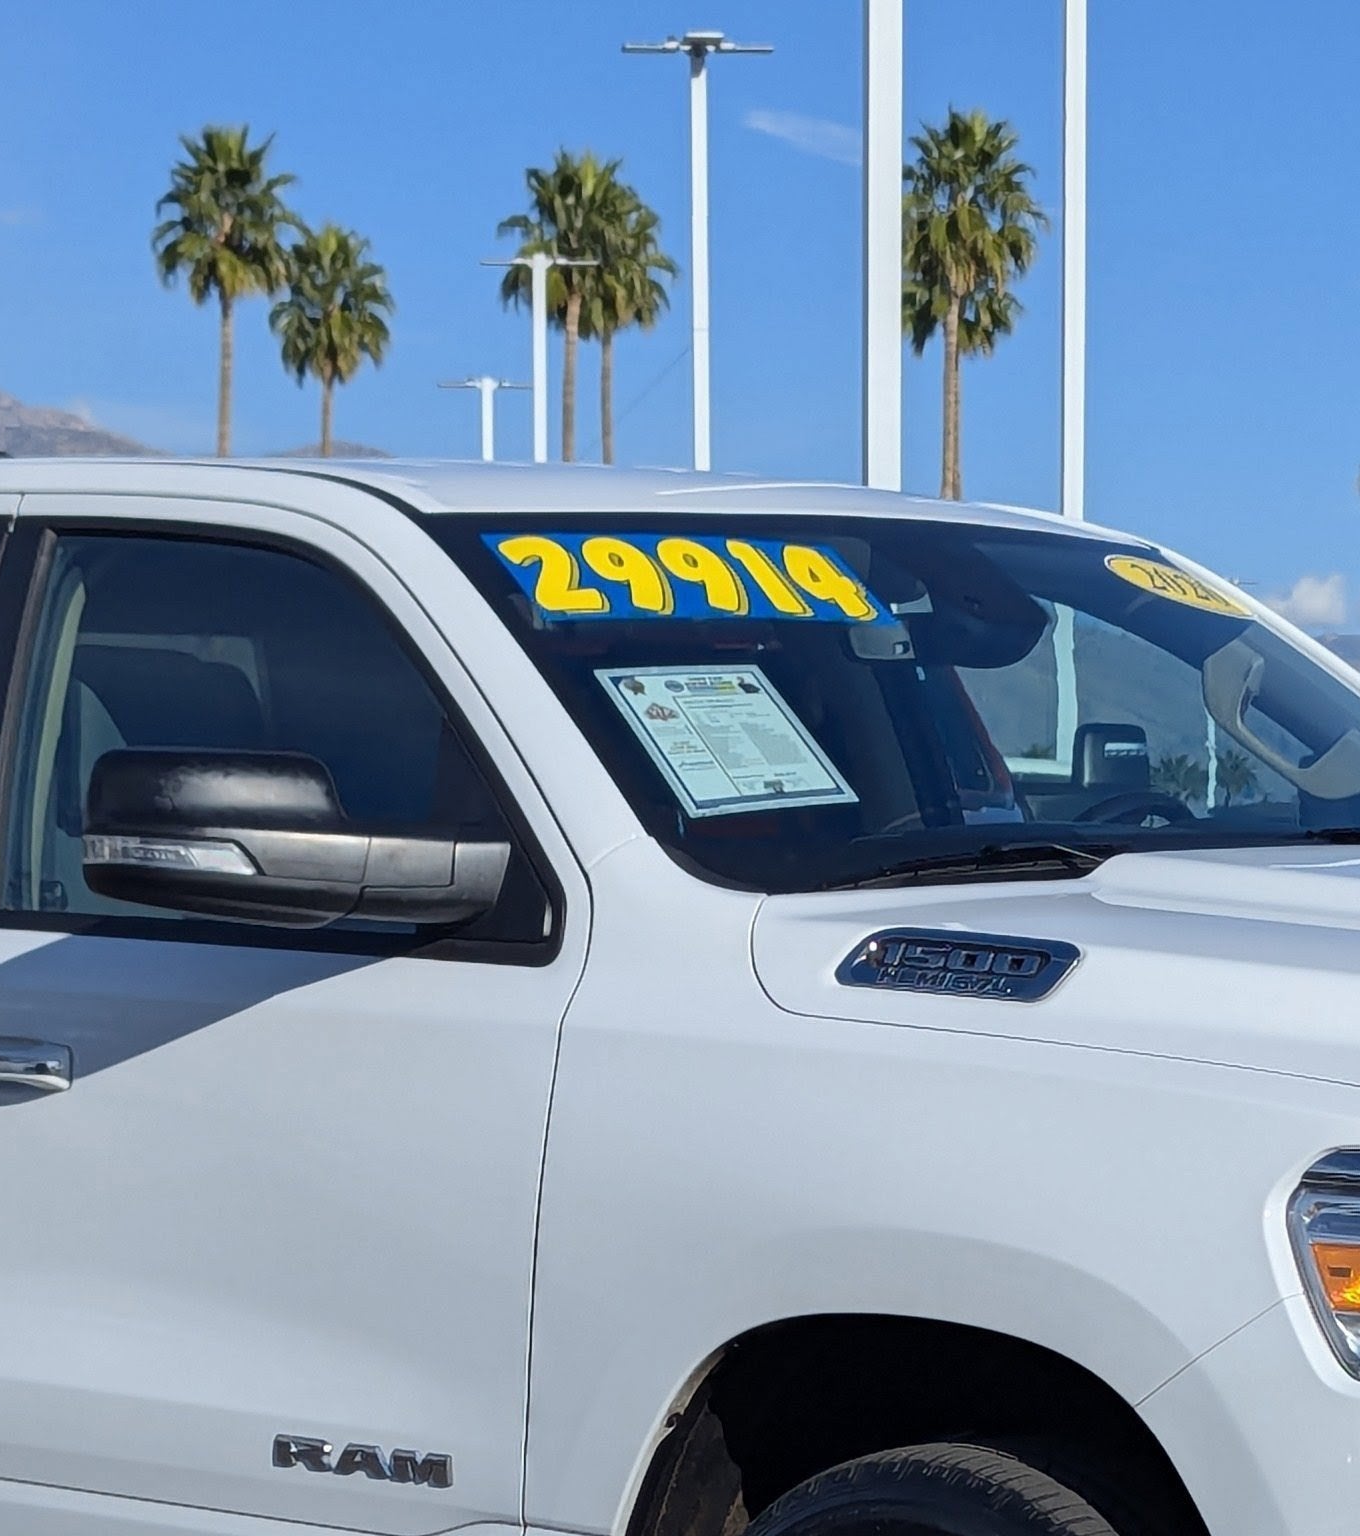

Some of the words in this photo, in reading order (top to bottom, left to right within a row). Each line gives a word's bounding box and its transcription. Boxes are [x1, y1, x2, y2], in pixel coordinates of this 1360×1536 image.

[497, 536, 878, 622] 29914
[883, 942, 1042, 977] 1500
[272, 1433, 454, 1488] RAM
